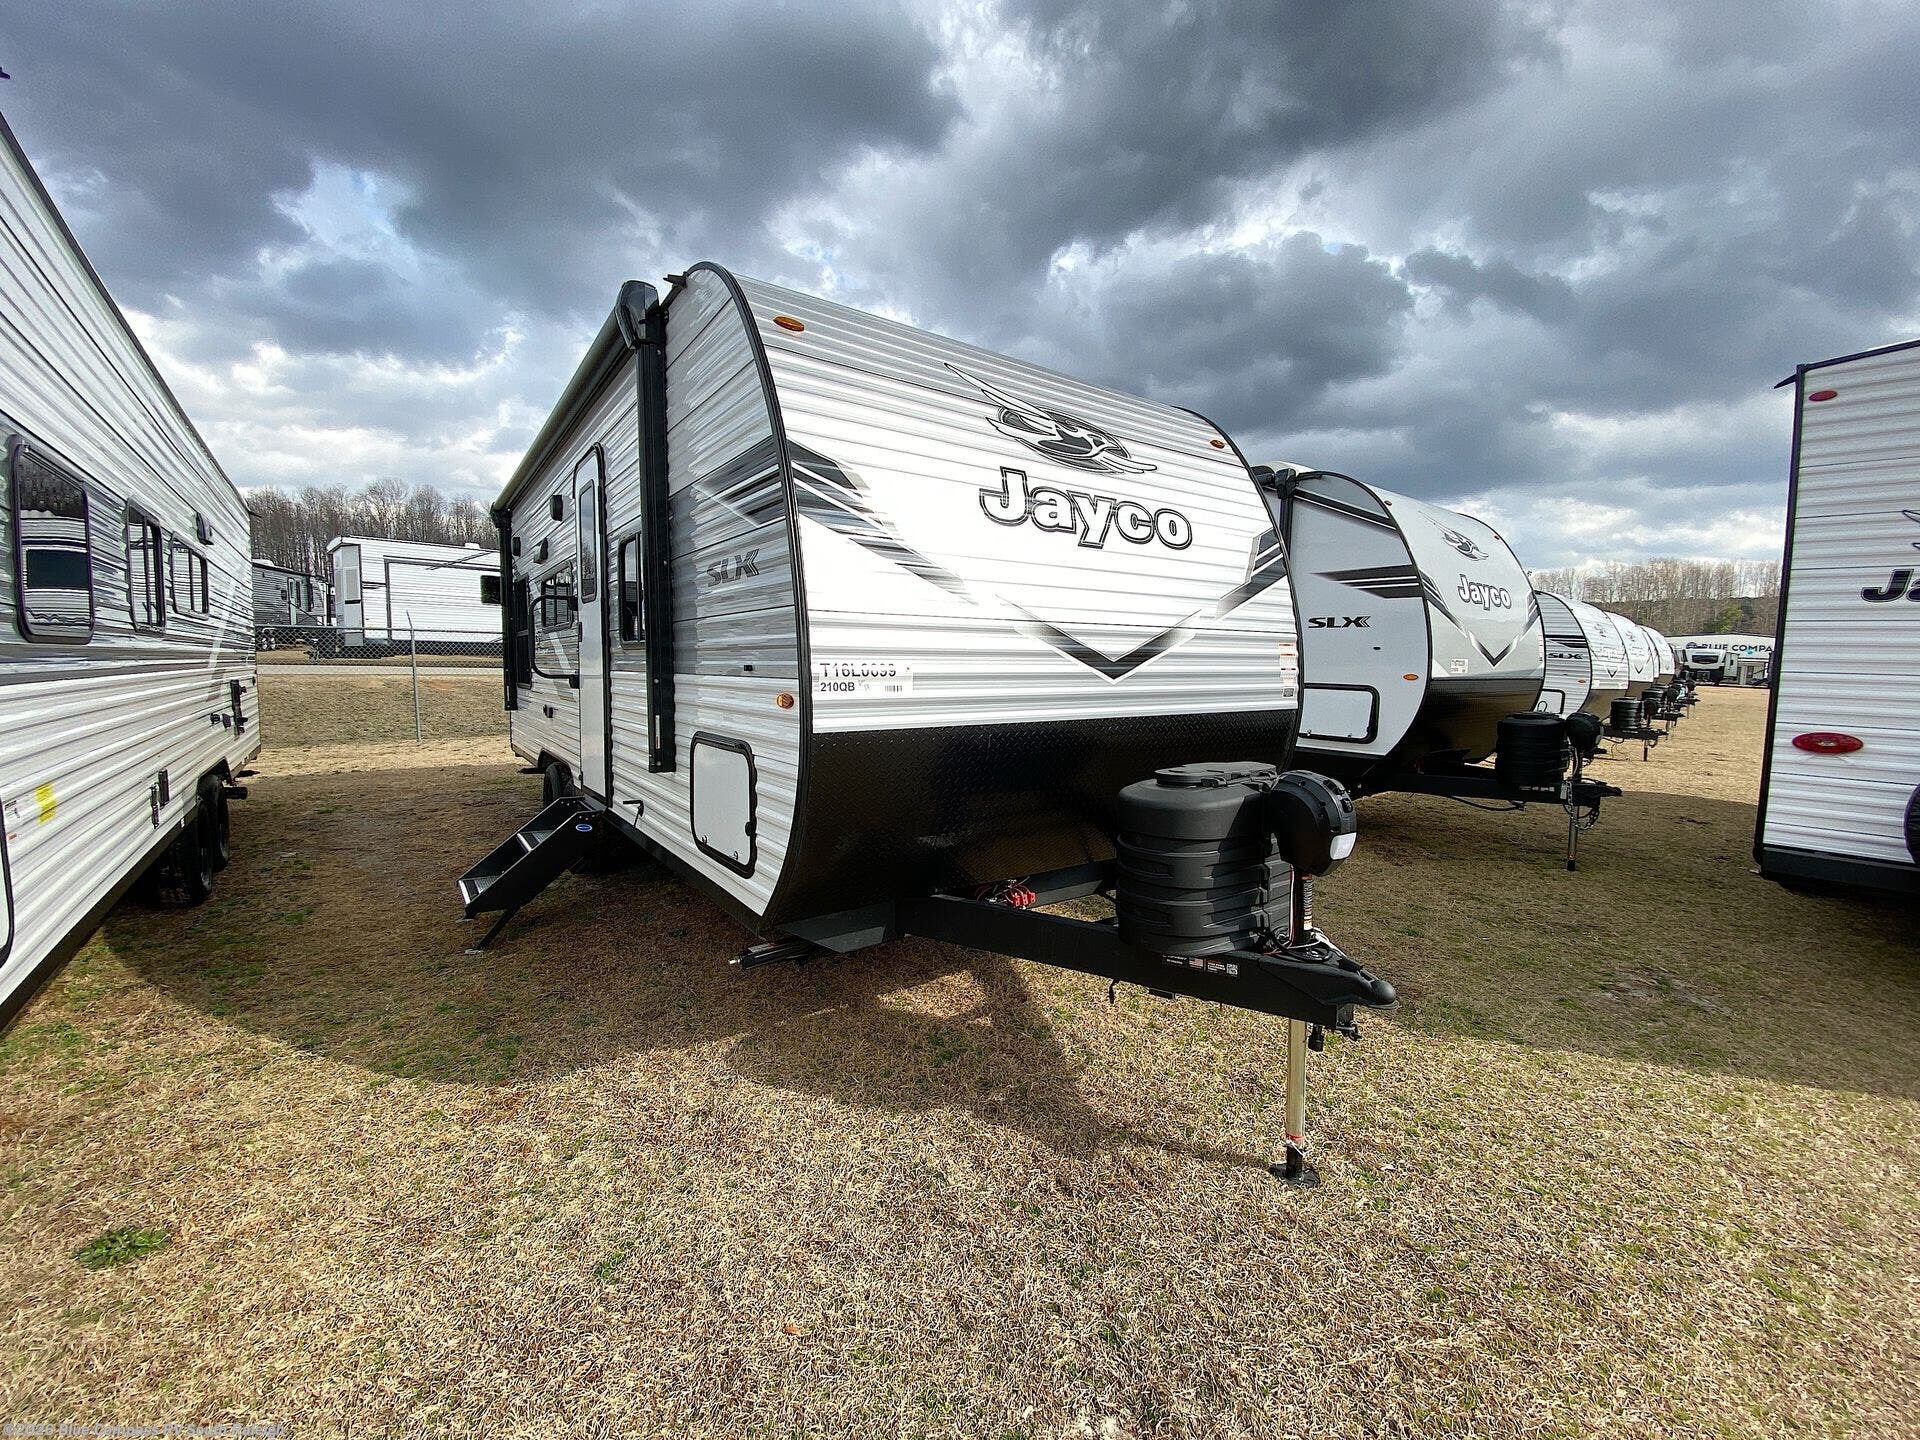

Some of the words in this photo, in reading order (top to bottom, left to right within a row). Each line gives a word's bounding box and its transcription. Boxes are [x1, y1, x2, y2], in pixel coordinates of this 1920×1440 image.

[979, 466, 1193, 550] Jayco
[1457, 573, 1512, 611] Jayco
[1308, 616, 1371, 629] SLX
[820, 681, 856, 693] 210QB
